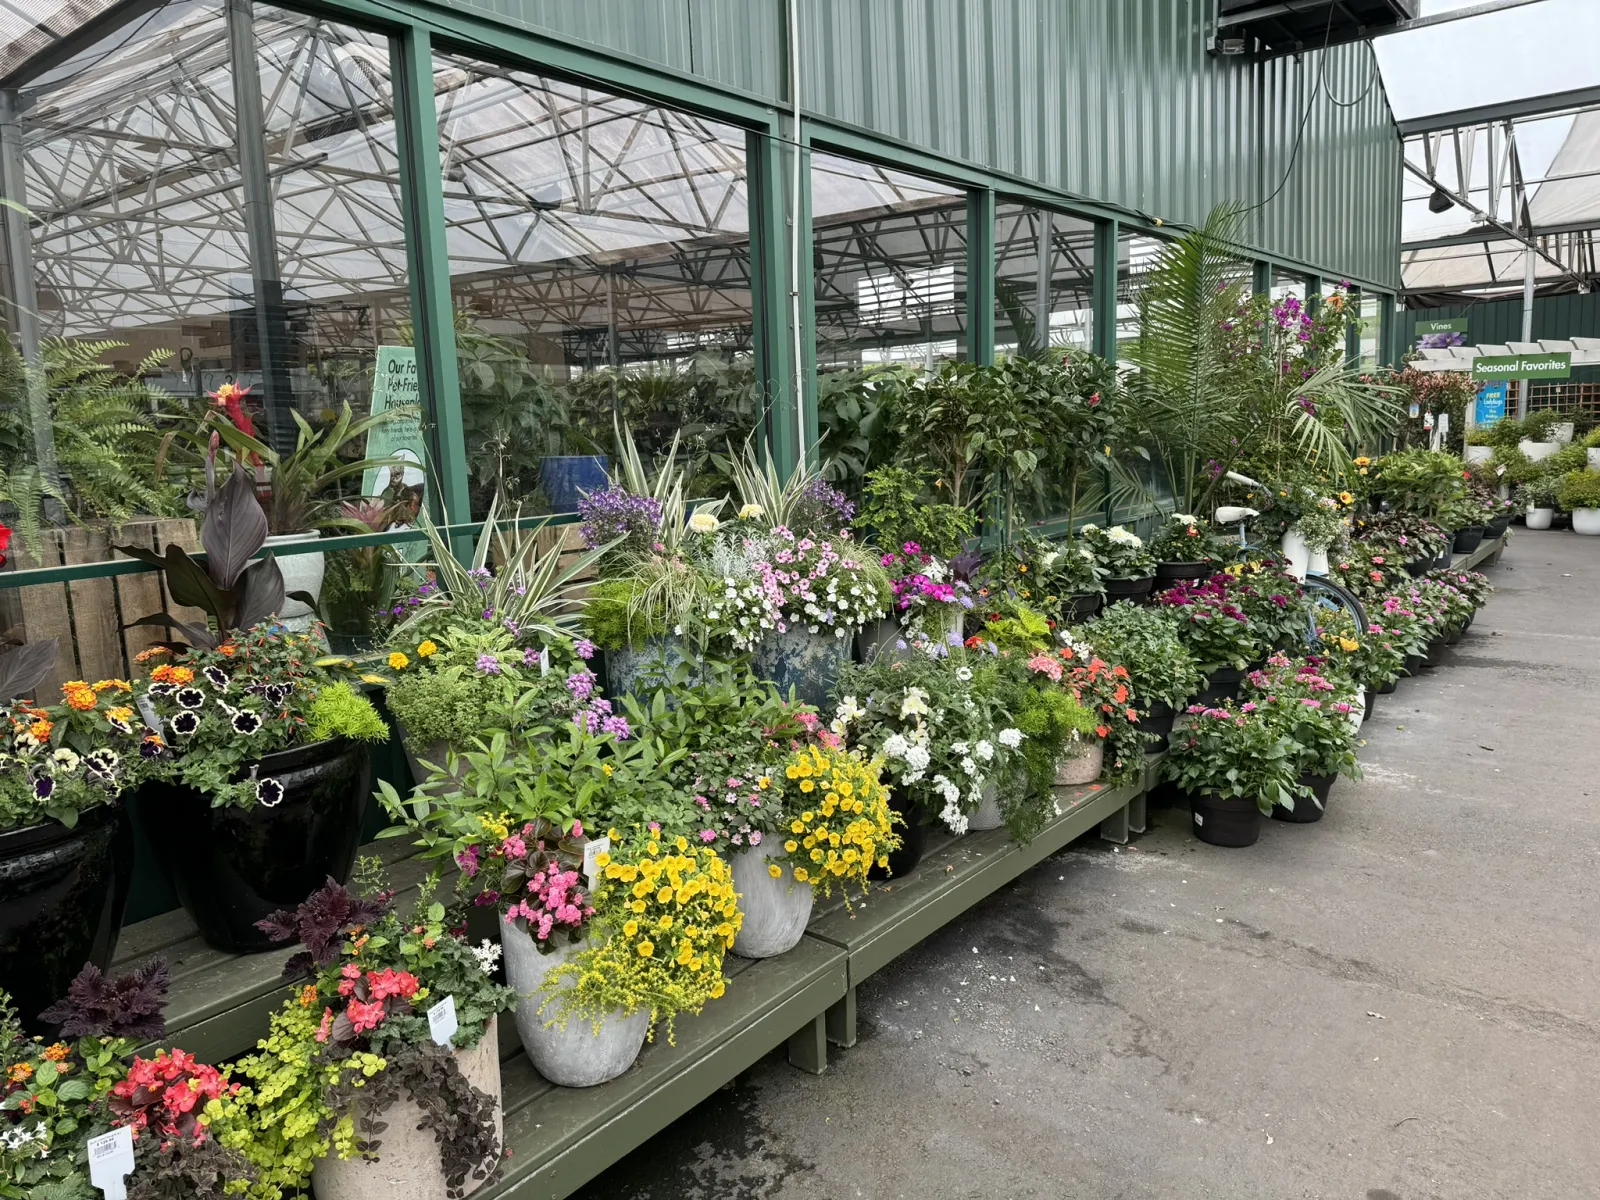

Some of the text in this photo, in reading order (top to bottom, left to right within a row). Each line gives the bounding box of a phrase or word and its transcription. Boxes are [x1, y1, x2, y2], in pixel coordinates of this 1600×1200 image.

[1430, 322, 1452, 331] Vines
[388, 359, 404, 375] Our
[1476, 359, 1566, 373] Seasonal Favorites
[388, 378, 419, 392] Pet-Frie
[1486, 391, 1501, 399] FREE
